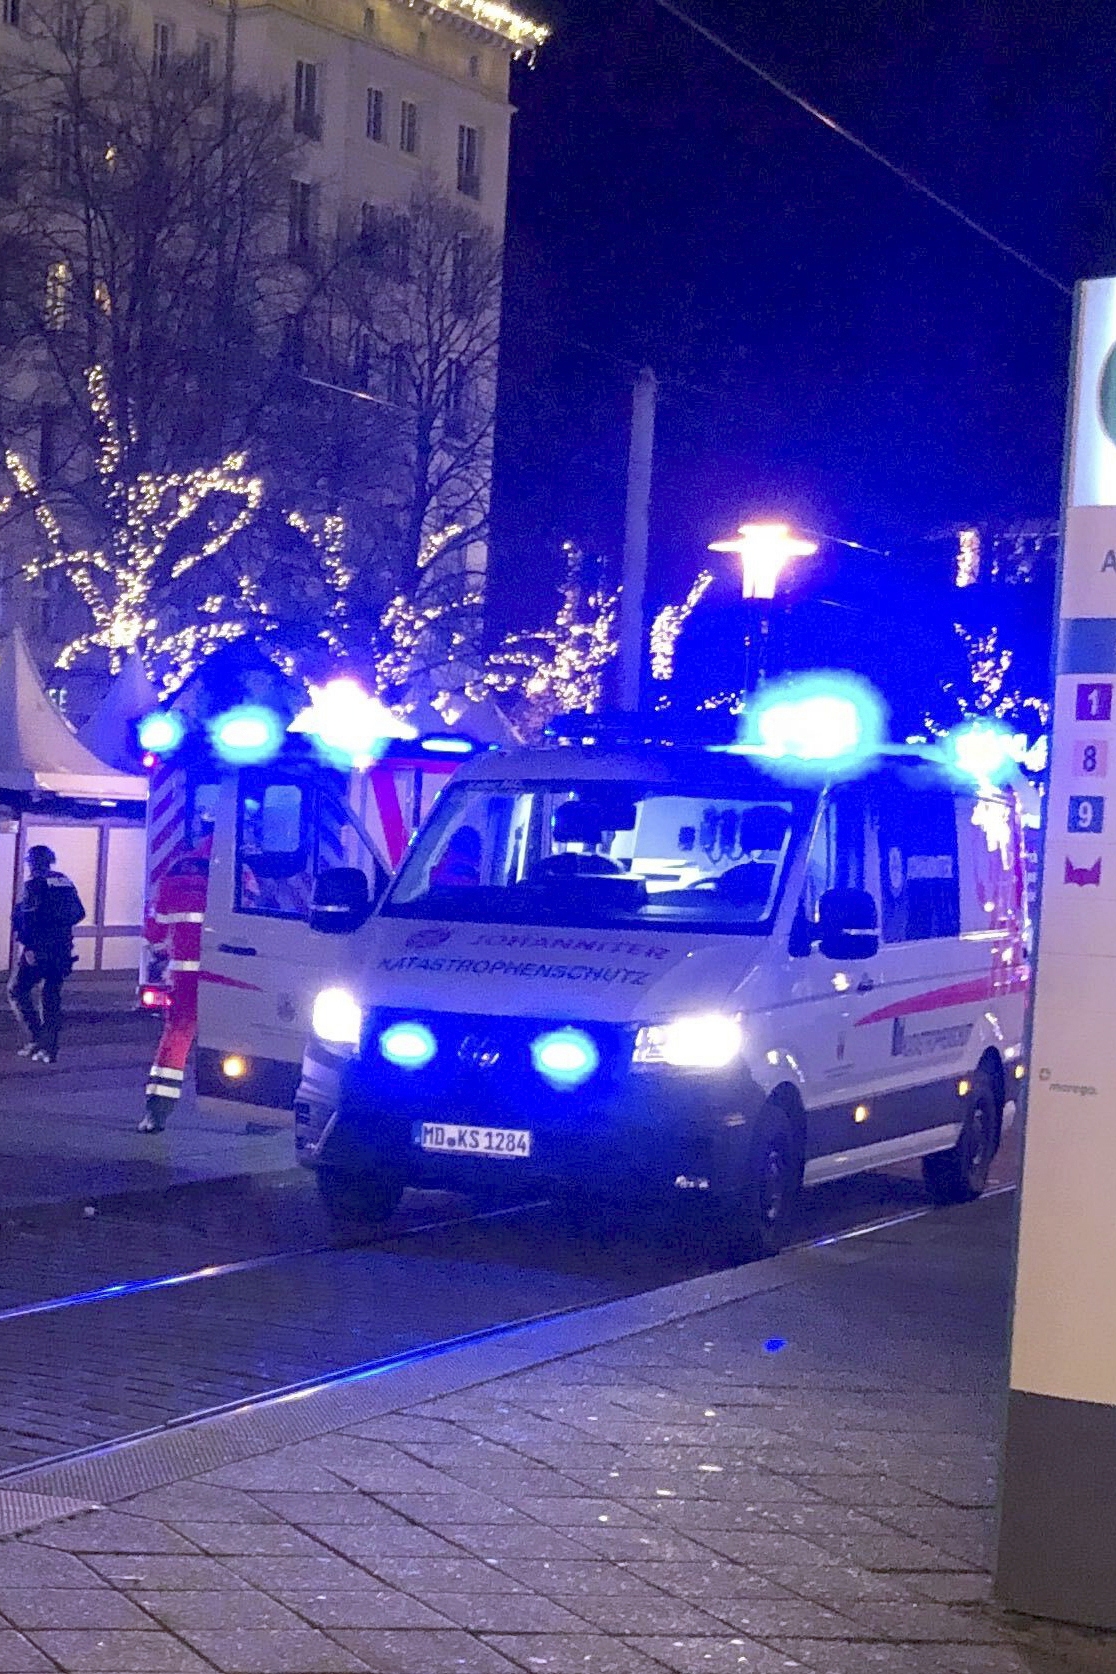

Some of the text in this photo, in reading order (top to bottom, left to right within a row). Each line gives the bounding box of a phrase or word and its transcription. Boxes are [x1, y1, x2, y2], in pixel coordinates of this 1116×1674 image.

[1087, 688, 1100, 717] 1
[1082, 745, 1097, 773] 8
[1078, 801, 1094, 828] 9
[469, 932, 671, 960] JOHANNITER
[377, 955, 653, 986] KATASTROPHENSCHUTZ
[424, 1126, 527, 1154] MD KS 1284
